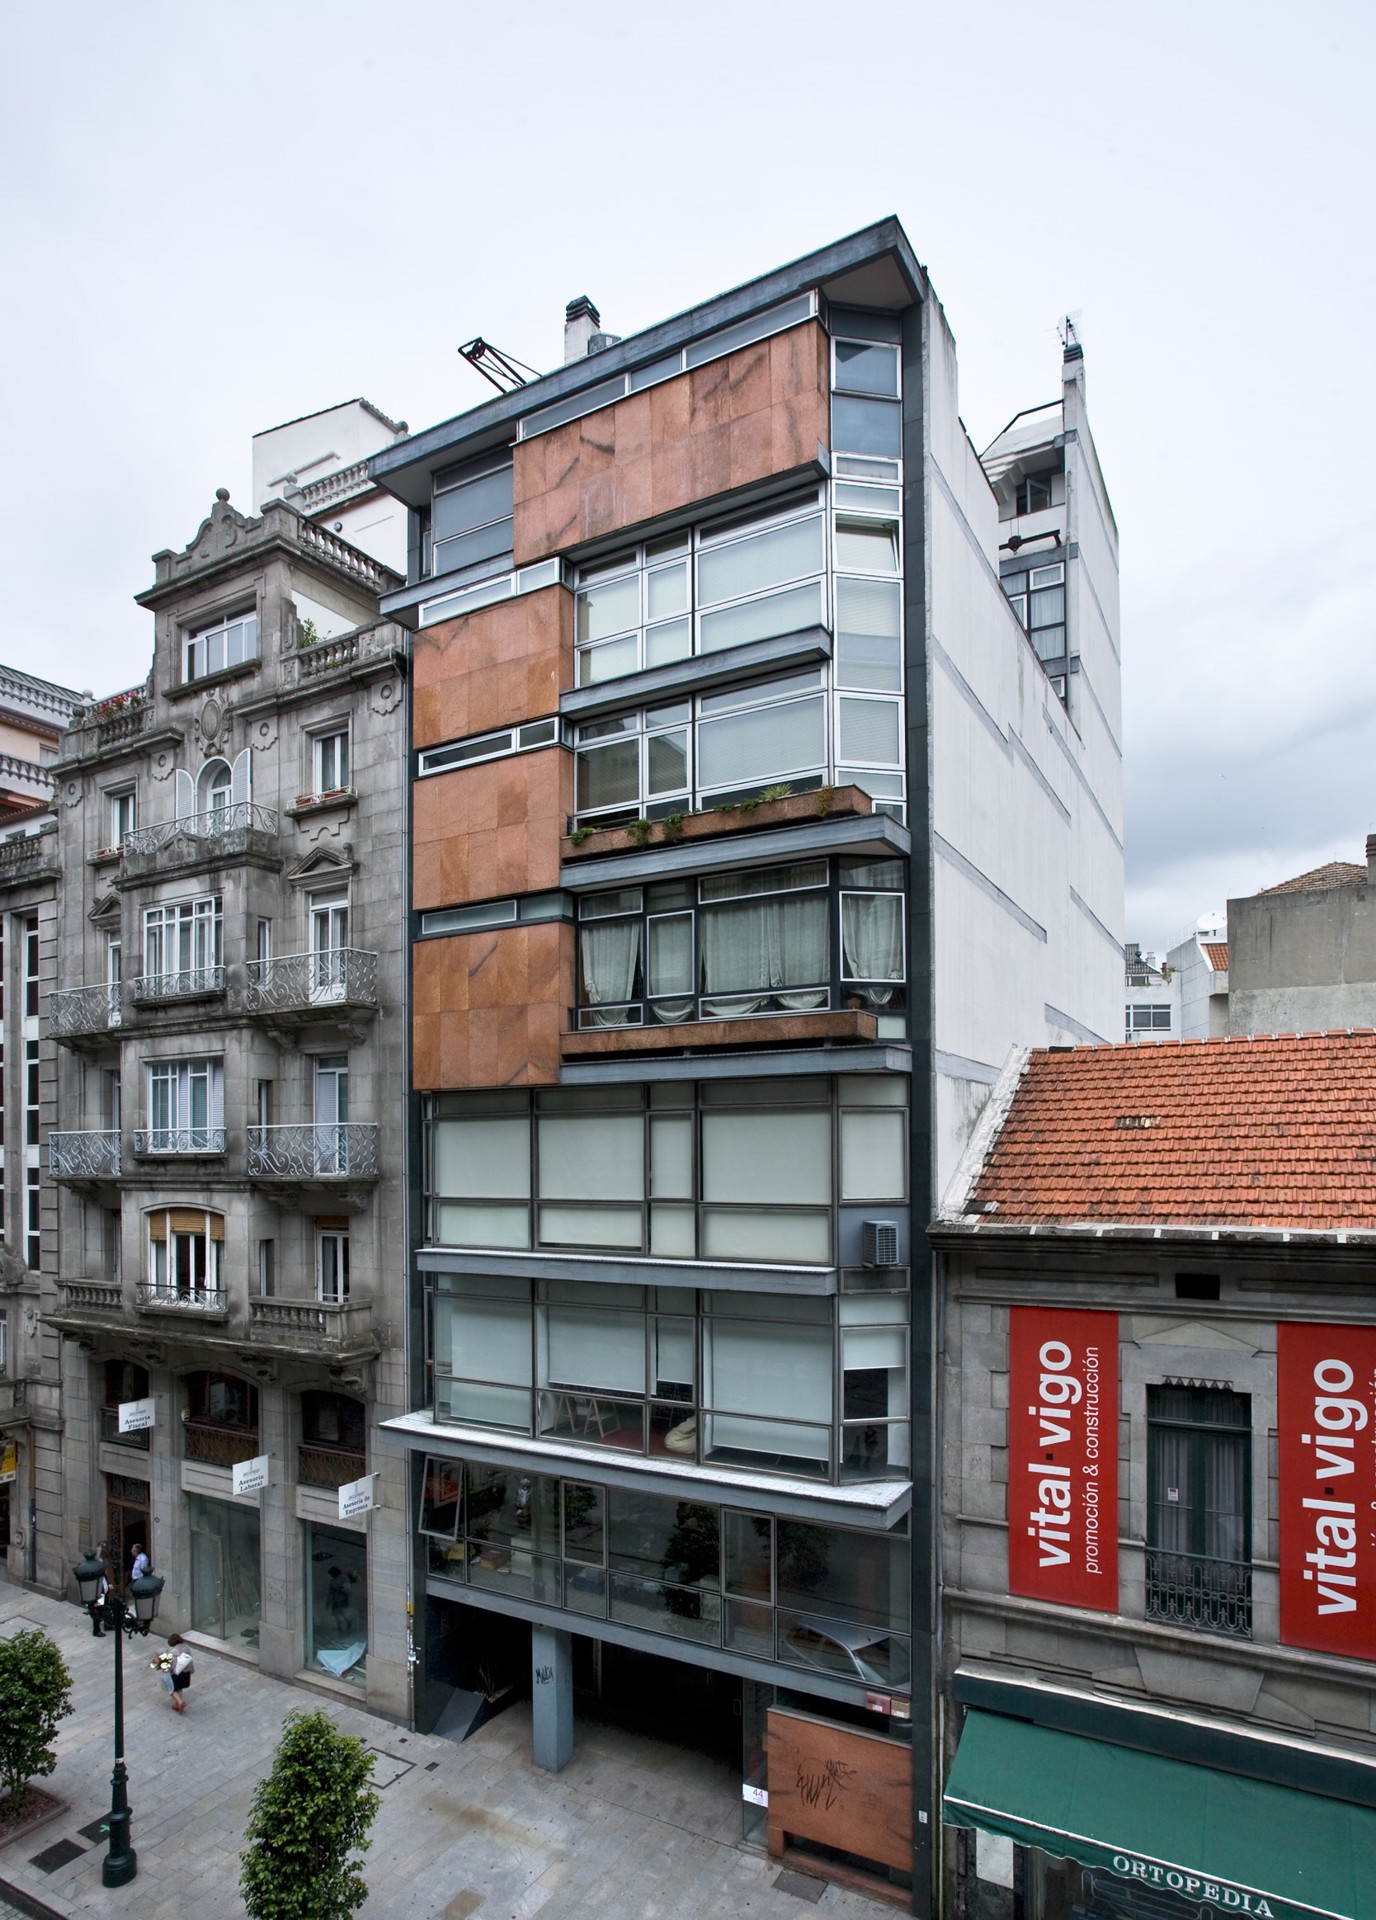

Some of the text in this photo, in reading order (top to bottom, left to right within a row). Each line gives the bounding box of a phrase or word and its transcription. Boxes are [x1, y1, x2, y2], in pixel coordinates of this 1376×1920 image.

[1083, 1346, 1102, 1574] promoción & construcción
[240, 1480, 263, 1492] Laboral
[752, 1788, 764, 1798] 44
[1113, 1855, 1275, 1919] ORTOPEDIA
